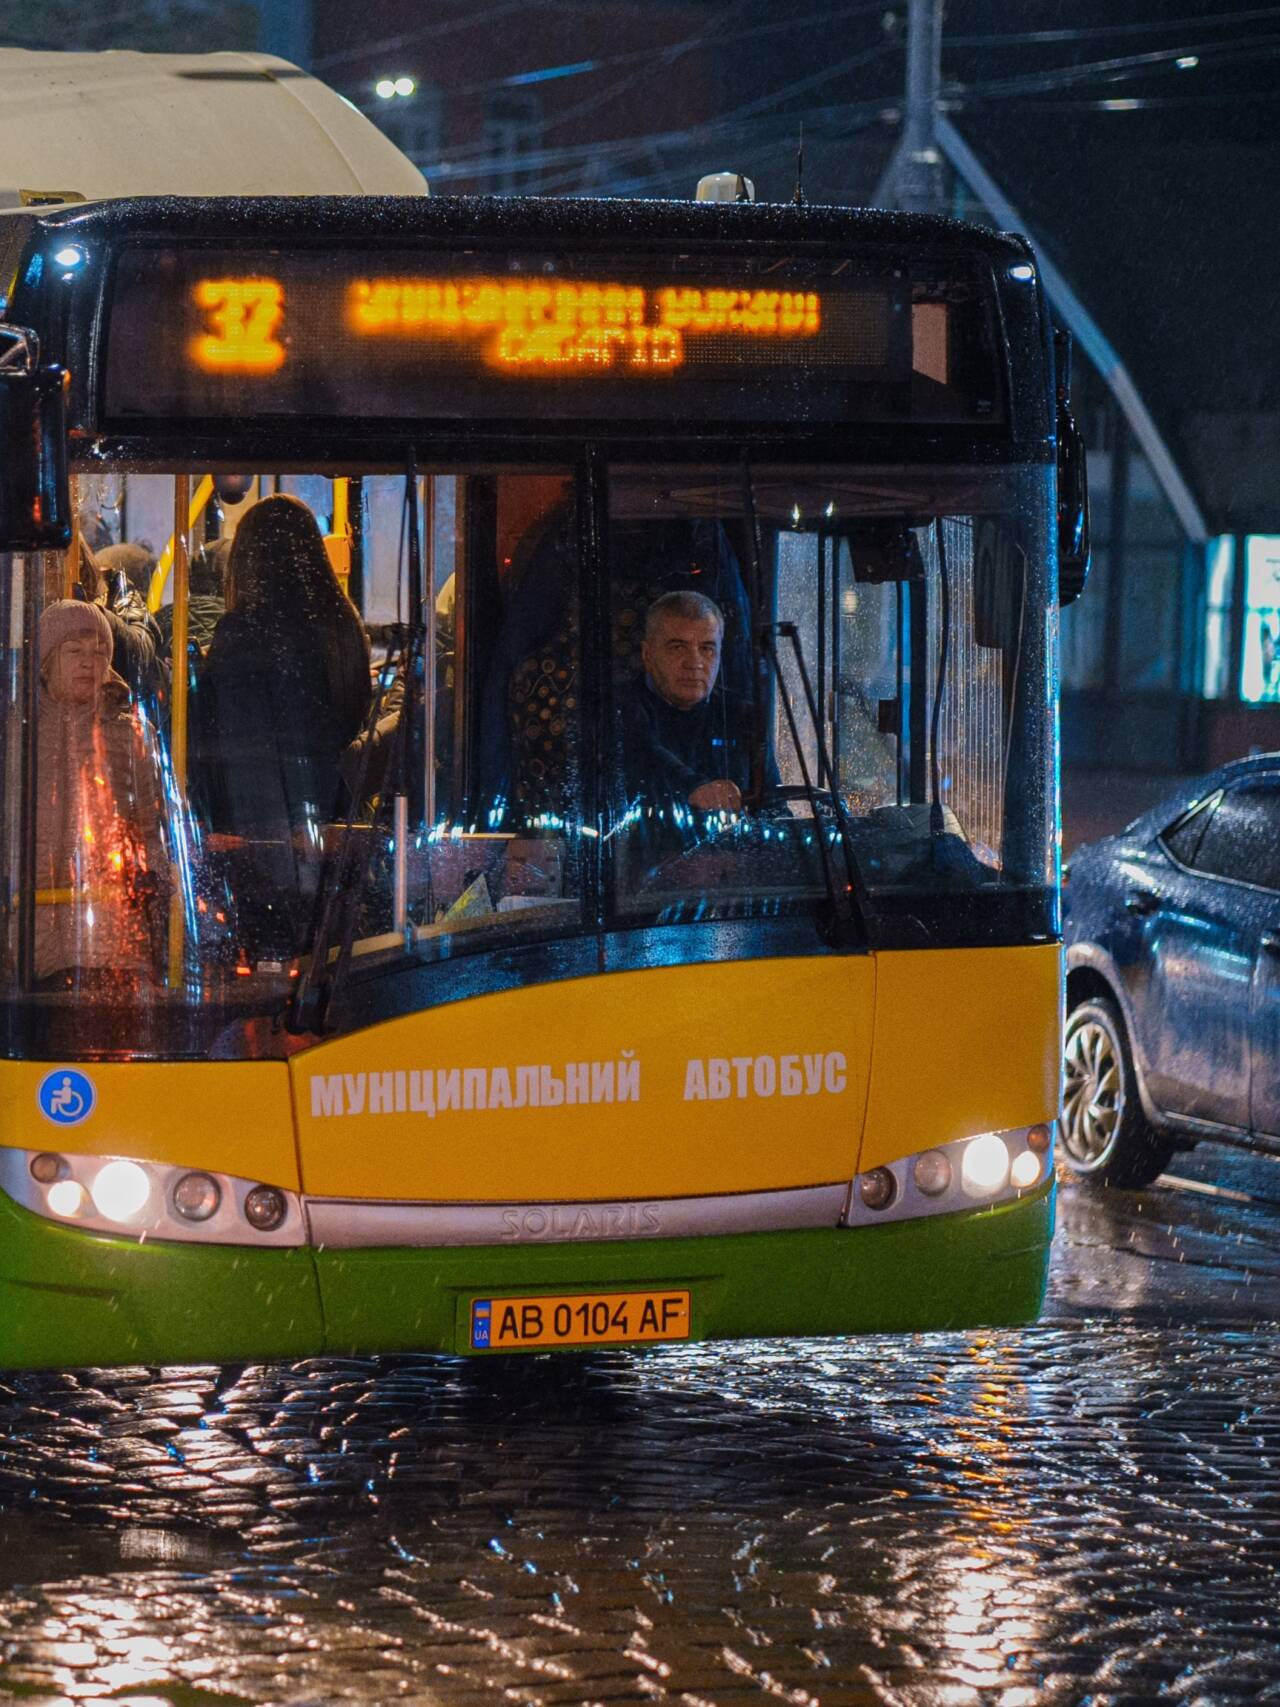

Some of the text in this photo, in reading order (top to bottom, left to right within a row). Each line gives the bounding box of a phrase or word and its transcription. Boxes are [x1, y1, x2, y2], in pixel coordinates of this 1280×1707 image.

[310, 1049, 847, 1119] МУНІЦИПАЛЬНИЙ АВТОБУС
[500, 1203, 661, 1239] SOLARIS
[474, 1330, 489, 1341] UA
[499, 1304, 543, 1340] AB
[554, 1300, 628, 1337] 0104
